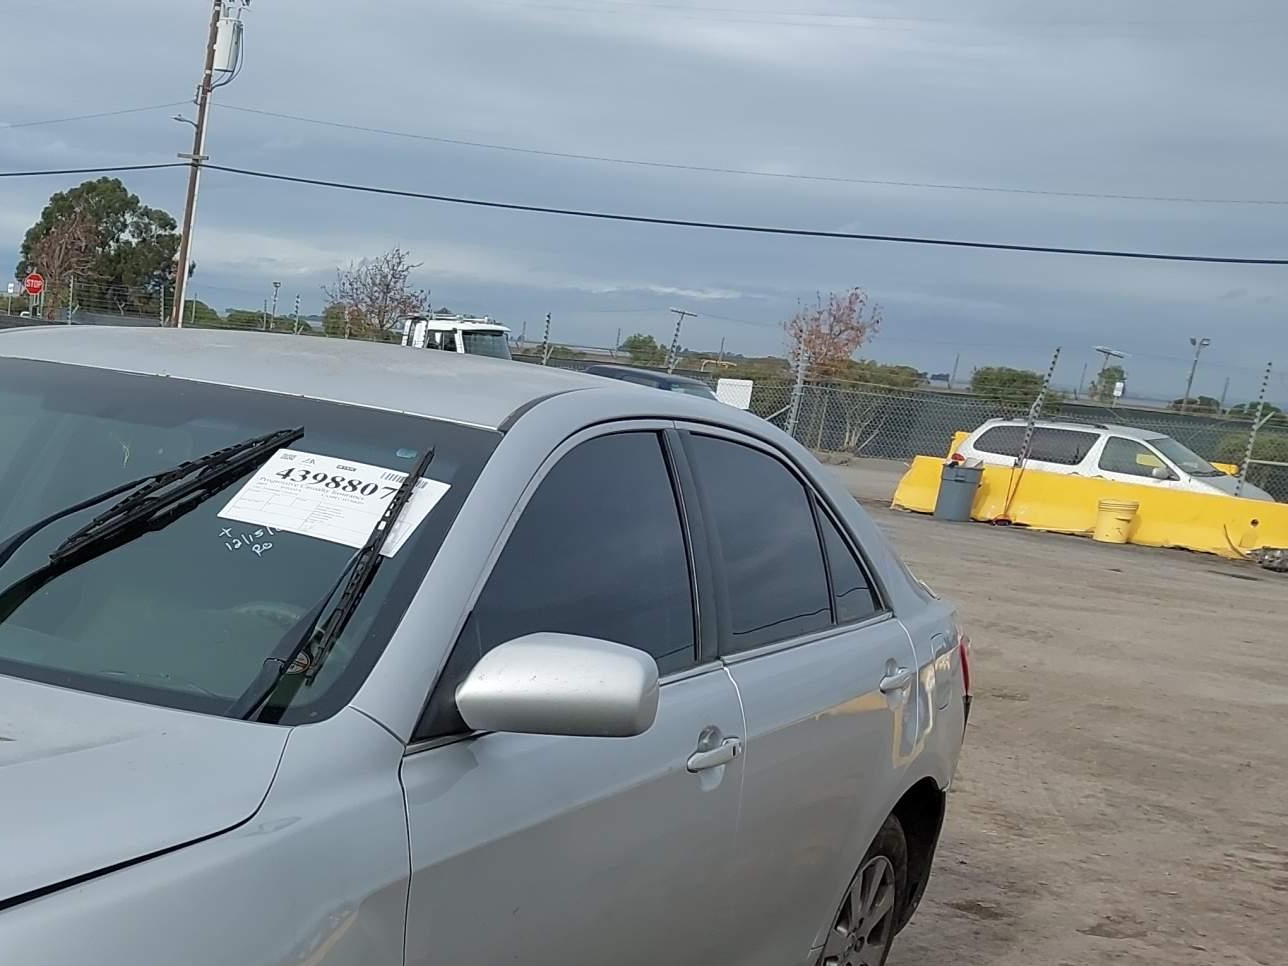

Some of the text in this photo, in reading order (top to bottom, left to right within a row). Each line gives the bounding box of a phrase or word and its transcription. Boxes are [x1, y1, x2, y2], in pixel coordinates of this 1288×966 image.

[26, 279, 43, 288] STOP
[276, 467, 406, 500] 4398807
[224, 526, 281, 551] 12/15/
